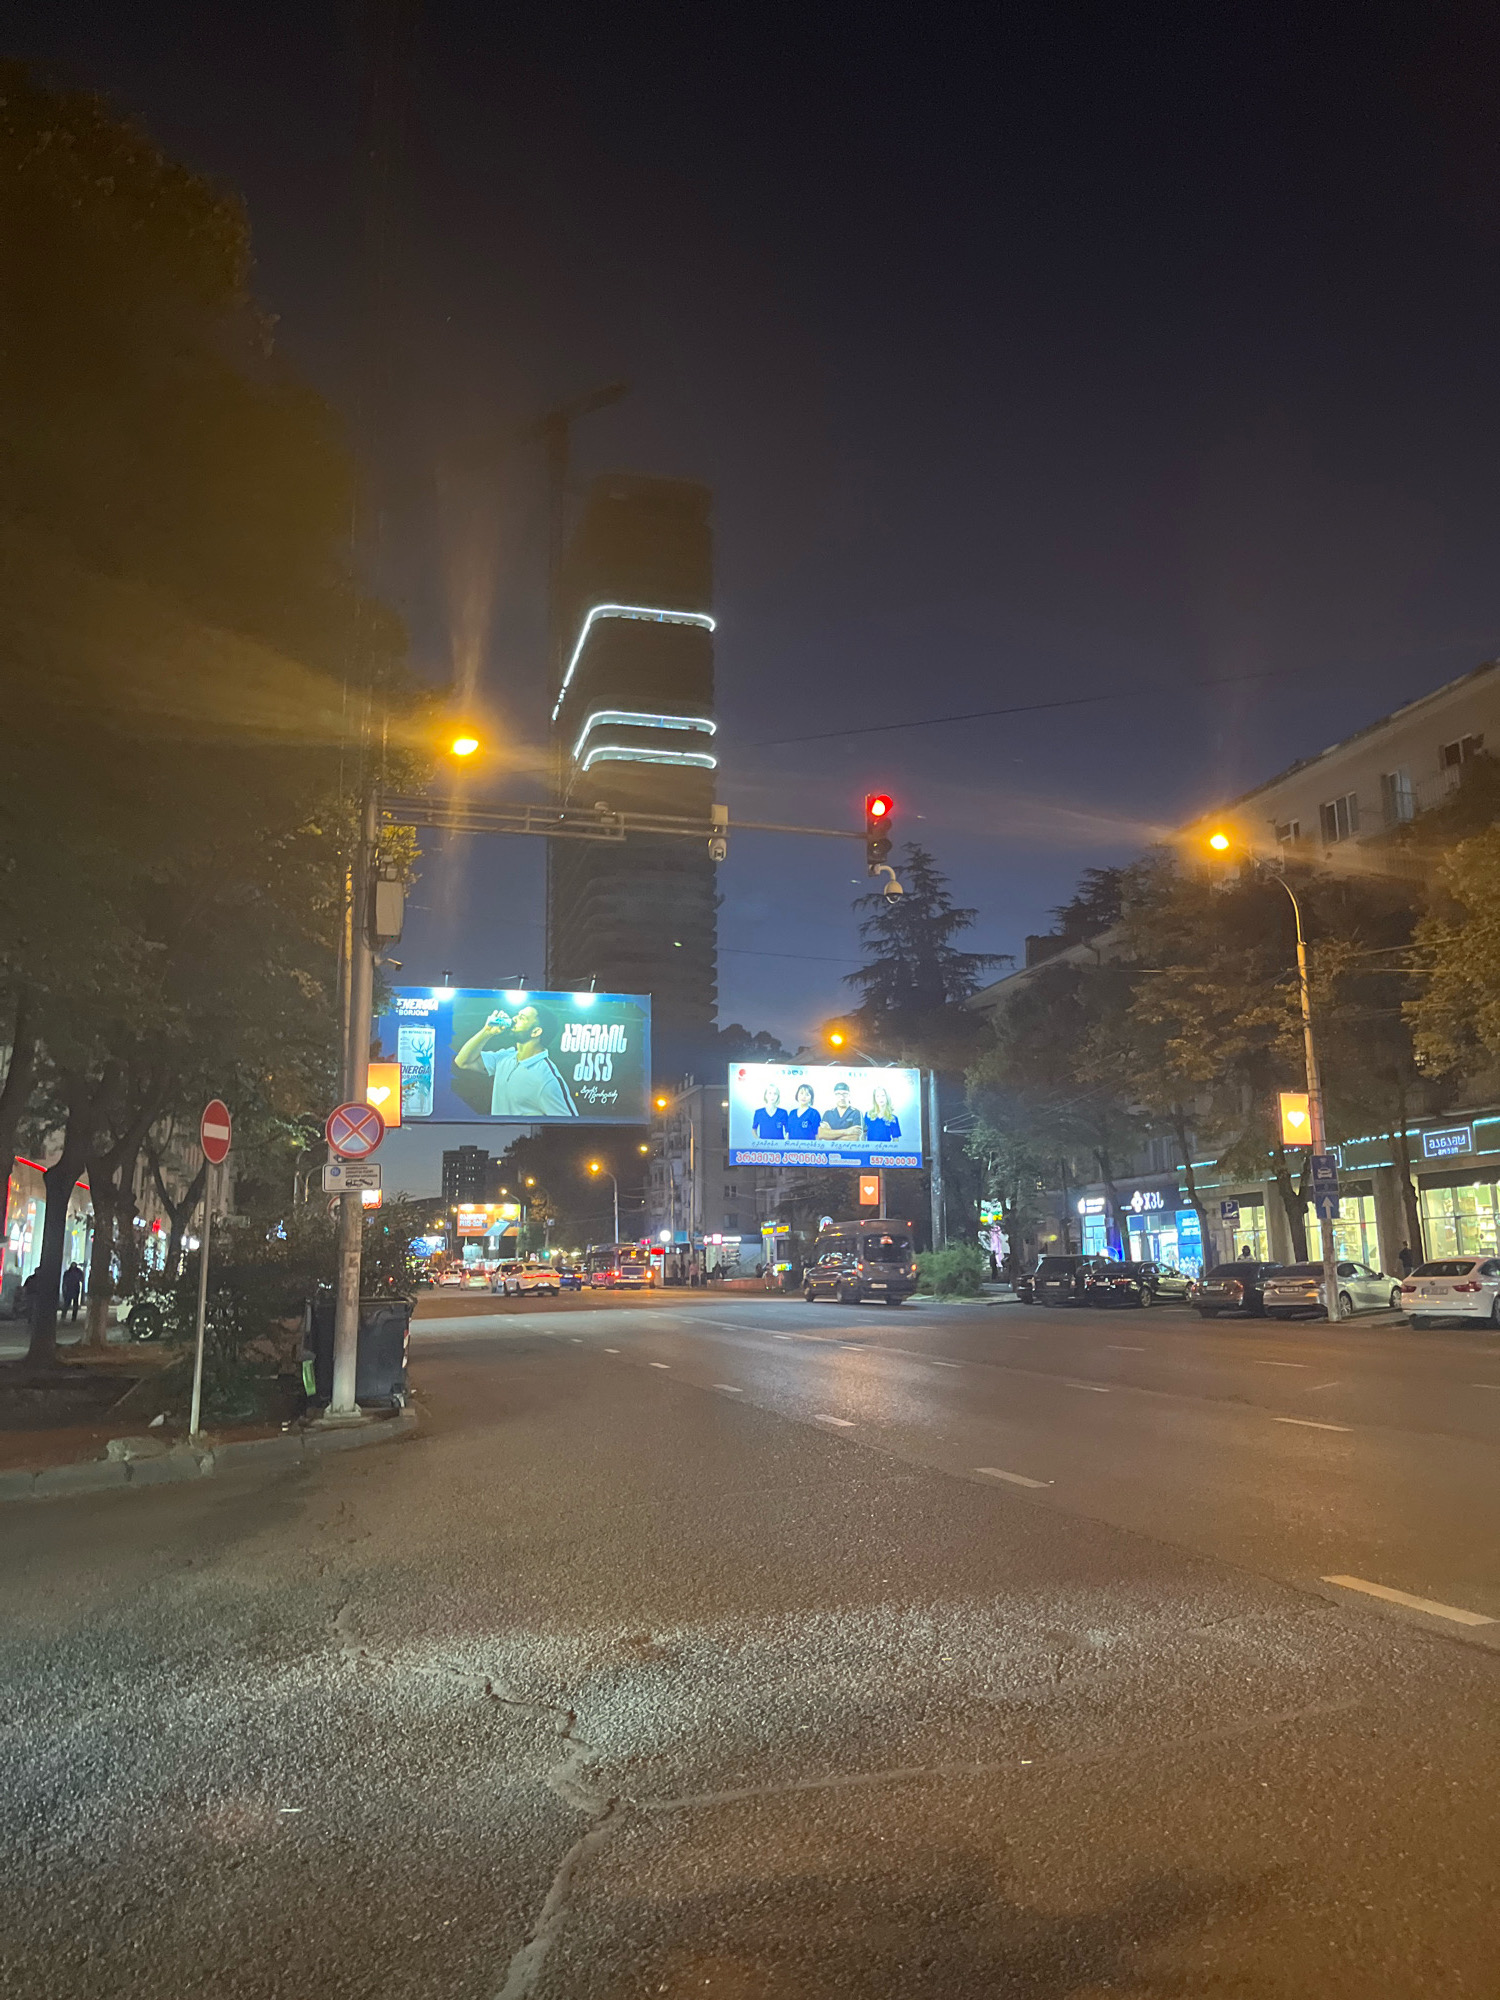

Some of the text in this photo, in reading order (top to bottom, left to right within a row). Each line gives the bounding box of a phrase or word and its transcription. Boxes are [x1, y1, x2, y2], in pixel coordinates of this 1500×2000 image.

[573, 1053, 612, 1081] ძალა
[736, 1152, 780, 1162] პრემიუმ
[782, 1153, 827, 1164] კლინიკა
[870, 1156, 883, 1165] 557
[884, 1157, 894, 1165] 30
[896, 1157, 905, 1166] 00
[906, 1157, 917, 1166] 30
[1225, 1202, 1233, 1212] P
